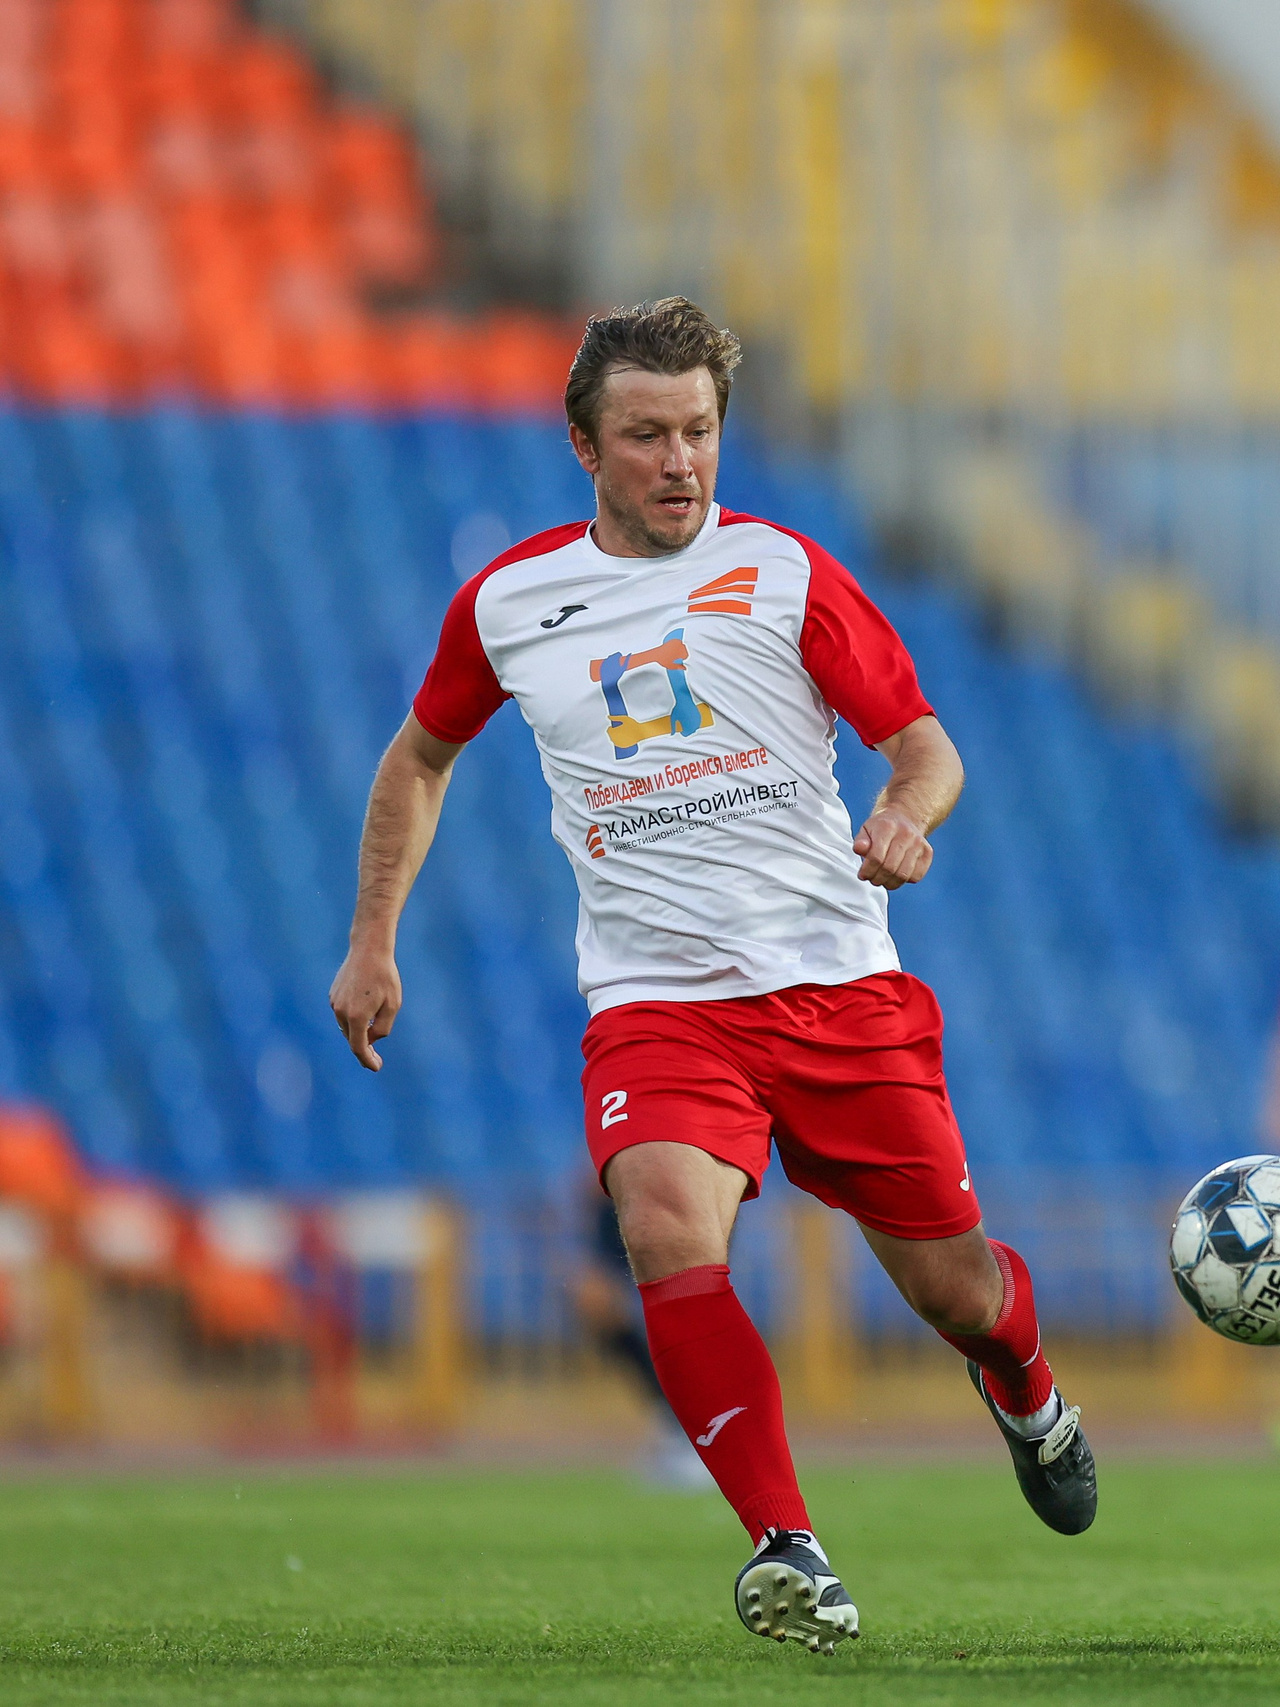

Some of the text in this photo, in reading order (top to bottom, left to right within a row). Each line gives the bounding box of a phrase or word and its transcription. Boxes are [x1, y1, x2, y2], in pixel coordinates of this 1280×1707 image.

[584, 746, 769, 811] Побеждаем и боремся вместе
[601, 1090, 629, 1131] 2
